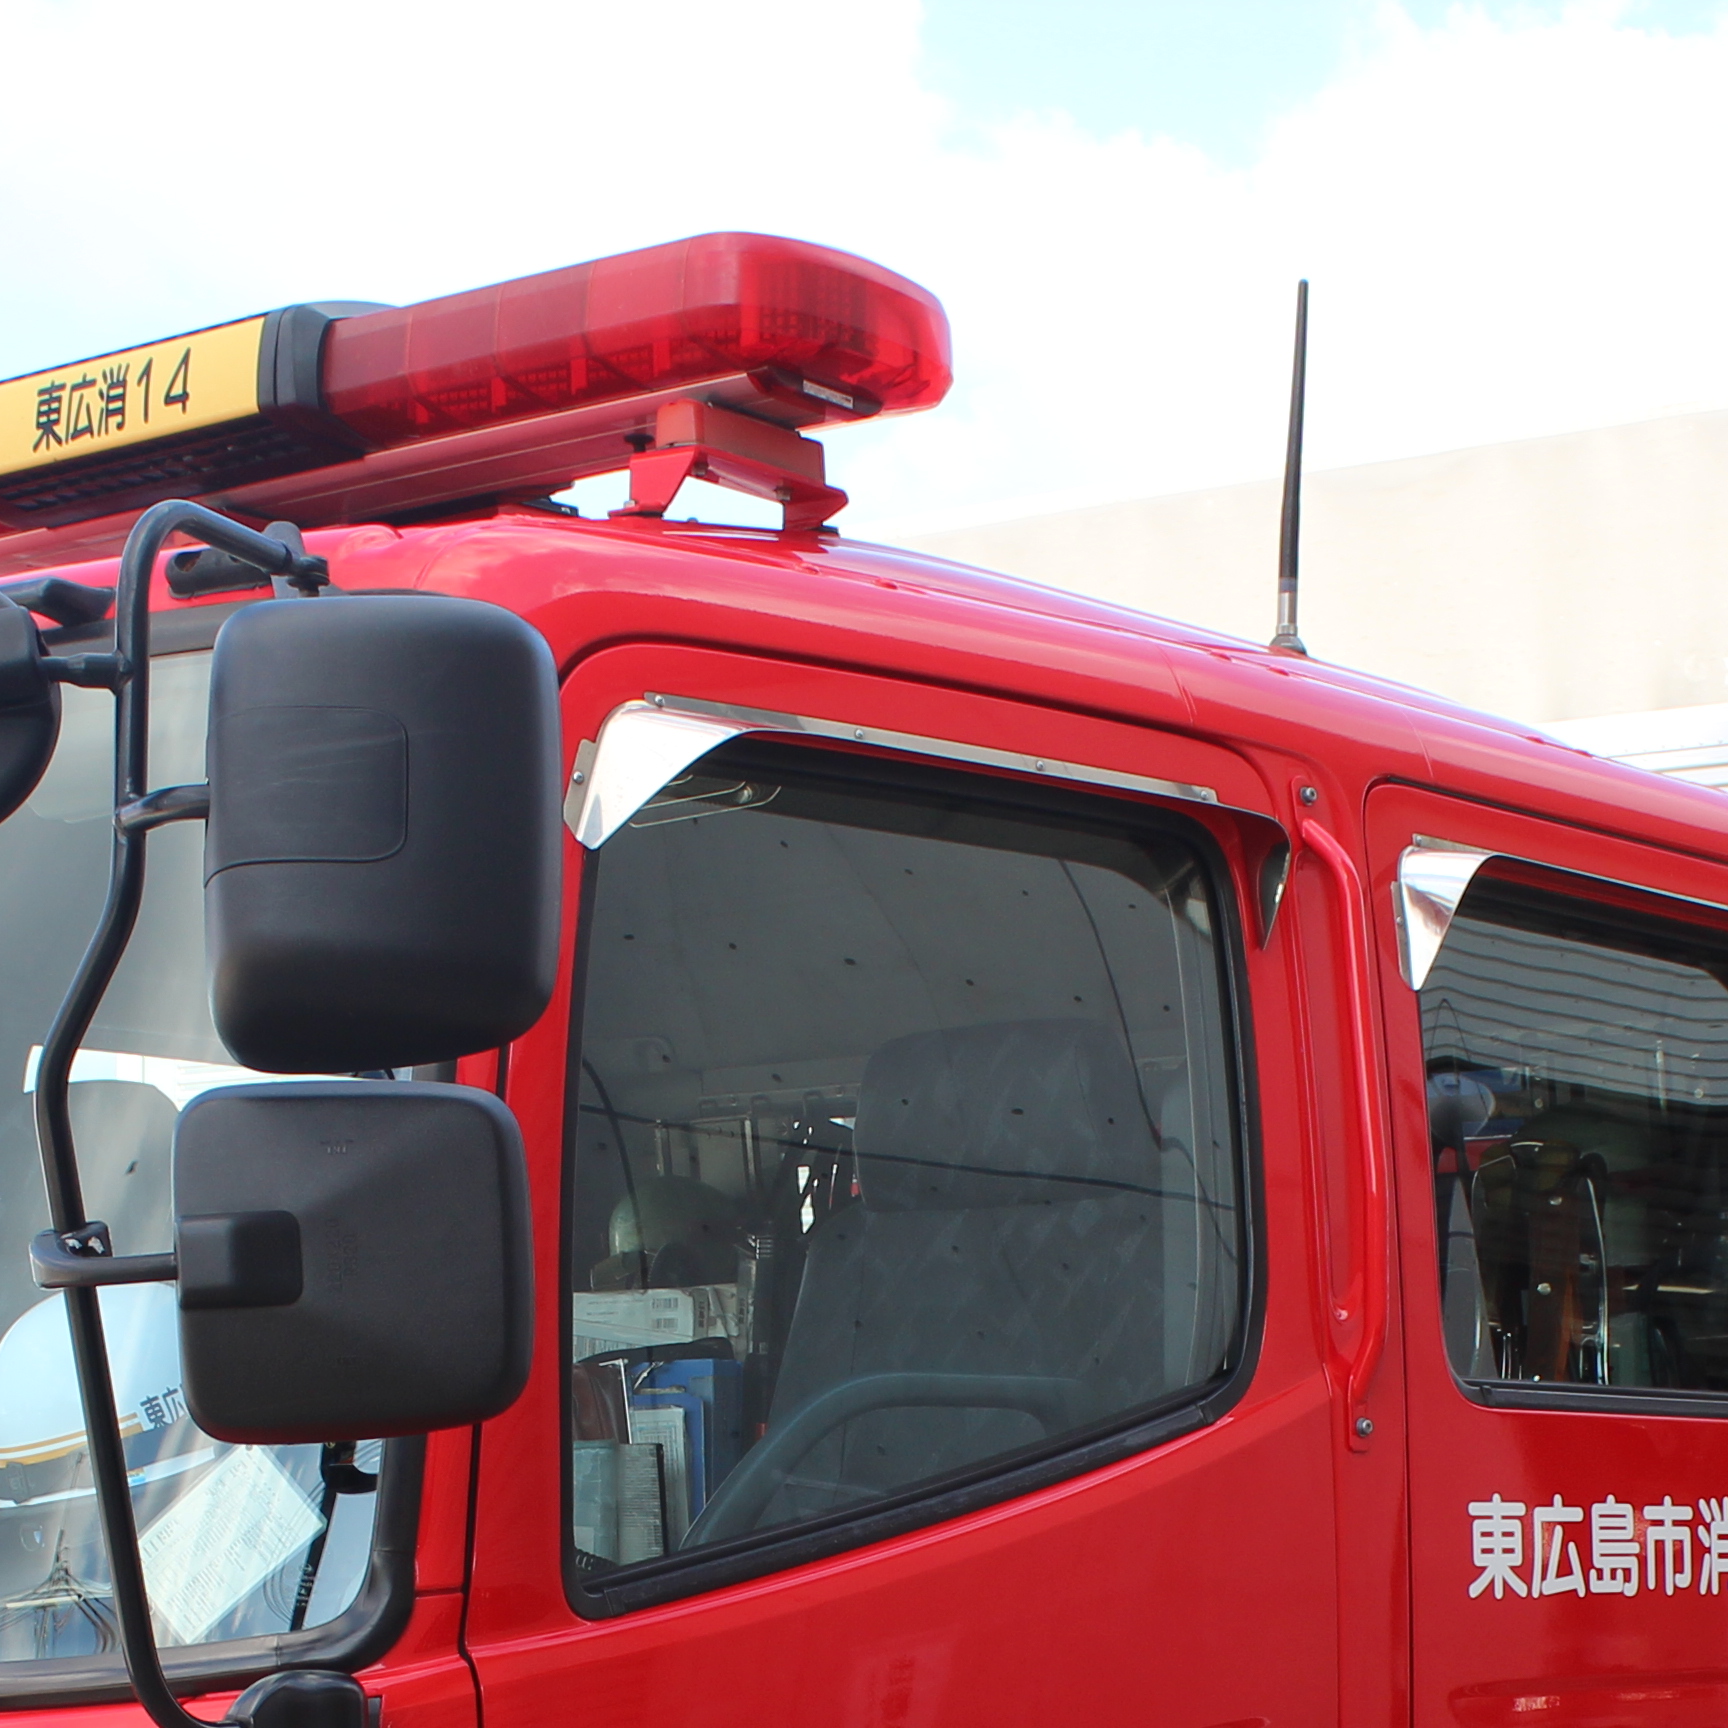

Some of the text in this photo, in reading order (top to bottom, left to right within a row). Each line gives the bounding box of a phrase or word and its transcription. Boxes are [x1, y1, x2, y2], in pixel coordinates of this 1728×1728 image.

[33, 347, 191, 452] 東広消14
[140, 1384, 188, 1428] 東広
